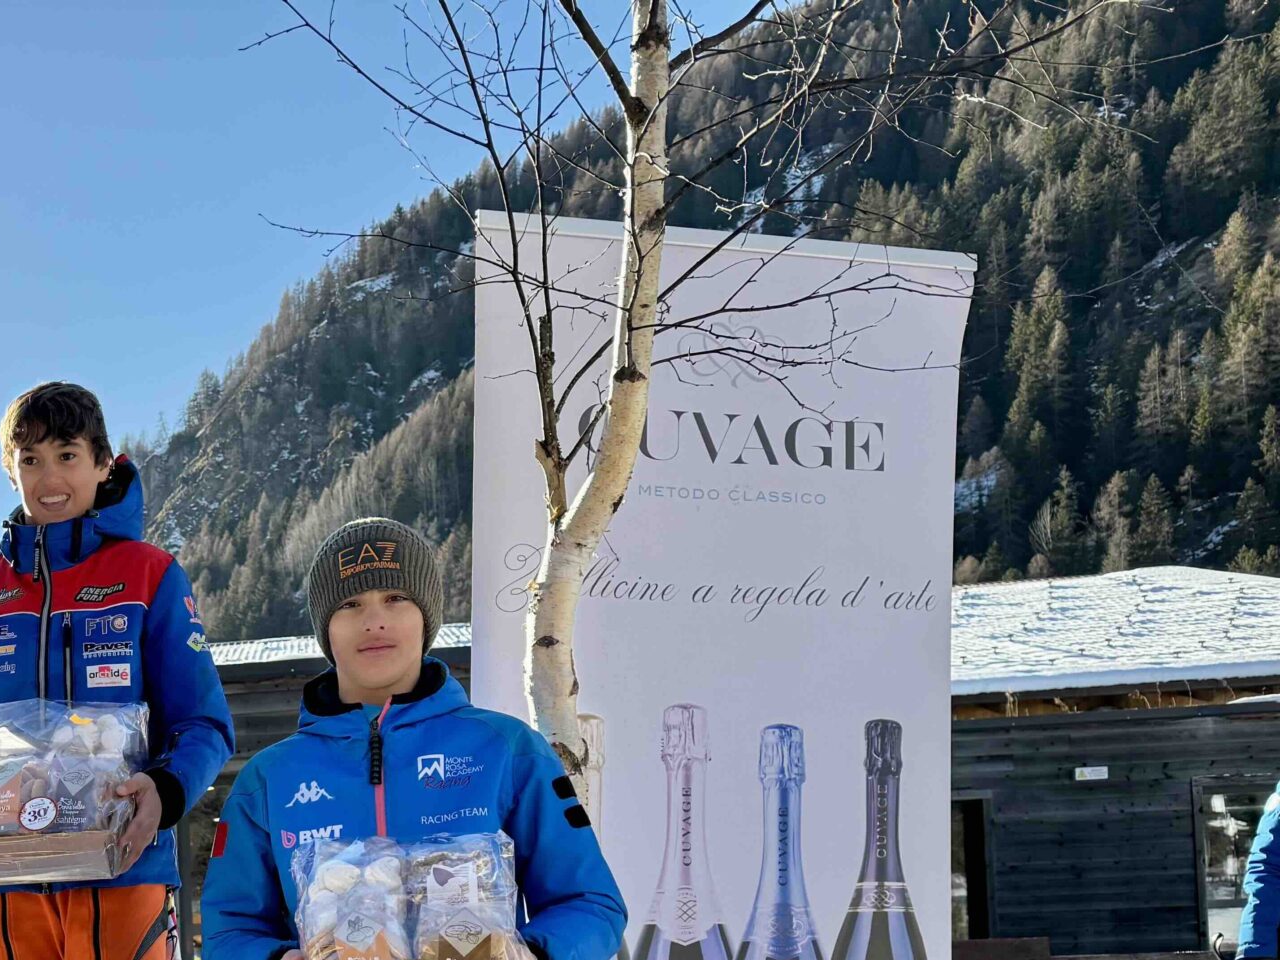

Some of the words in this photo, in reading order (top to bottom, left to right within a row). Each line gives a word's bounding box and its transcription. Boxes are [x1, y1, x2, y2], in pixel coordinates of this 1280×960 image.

[638, 484, 720, 501] METODO
[728, 487, 827, 505] CLASSICO
[338, 541, 397, 571] EA7
[340, 563, 368, 579] EMPORIO
[374, 560, 400, 570] ARMANI
[76, 594, 104, 602] PURA
[80, 583, 124, 596] ENERGIA
[691, 584, 719, 604] a
[730, 565, 831, 624] regola
[83, 641, 133, 653] Paver
[445, 756, 473, 765] MONTE
[445, 765, 484, 778] ACADEMY
[421, 811, 458, 825] RACING
[459, 807, 488, 817] TEAM
[877, 784, 888, 859] CUVAGE
[299, 824, 343, 845] BWT
[681, 787, 692, 867] CUVAGE
[778, 807, 789, 887] CUVAGE
